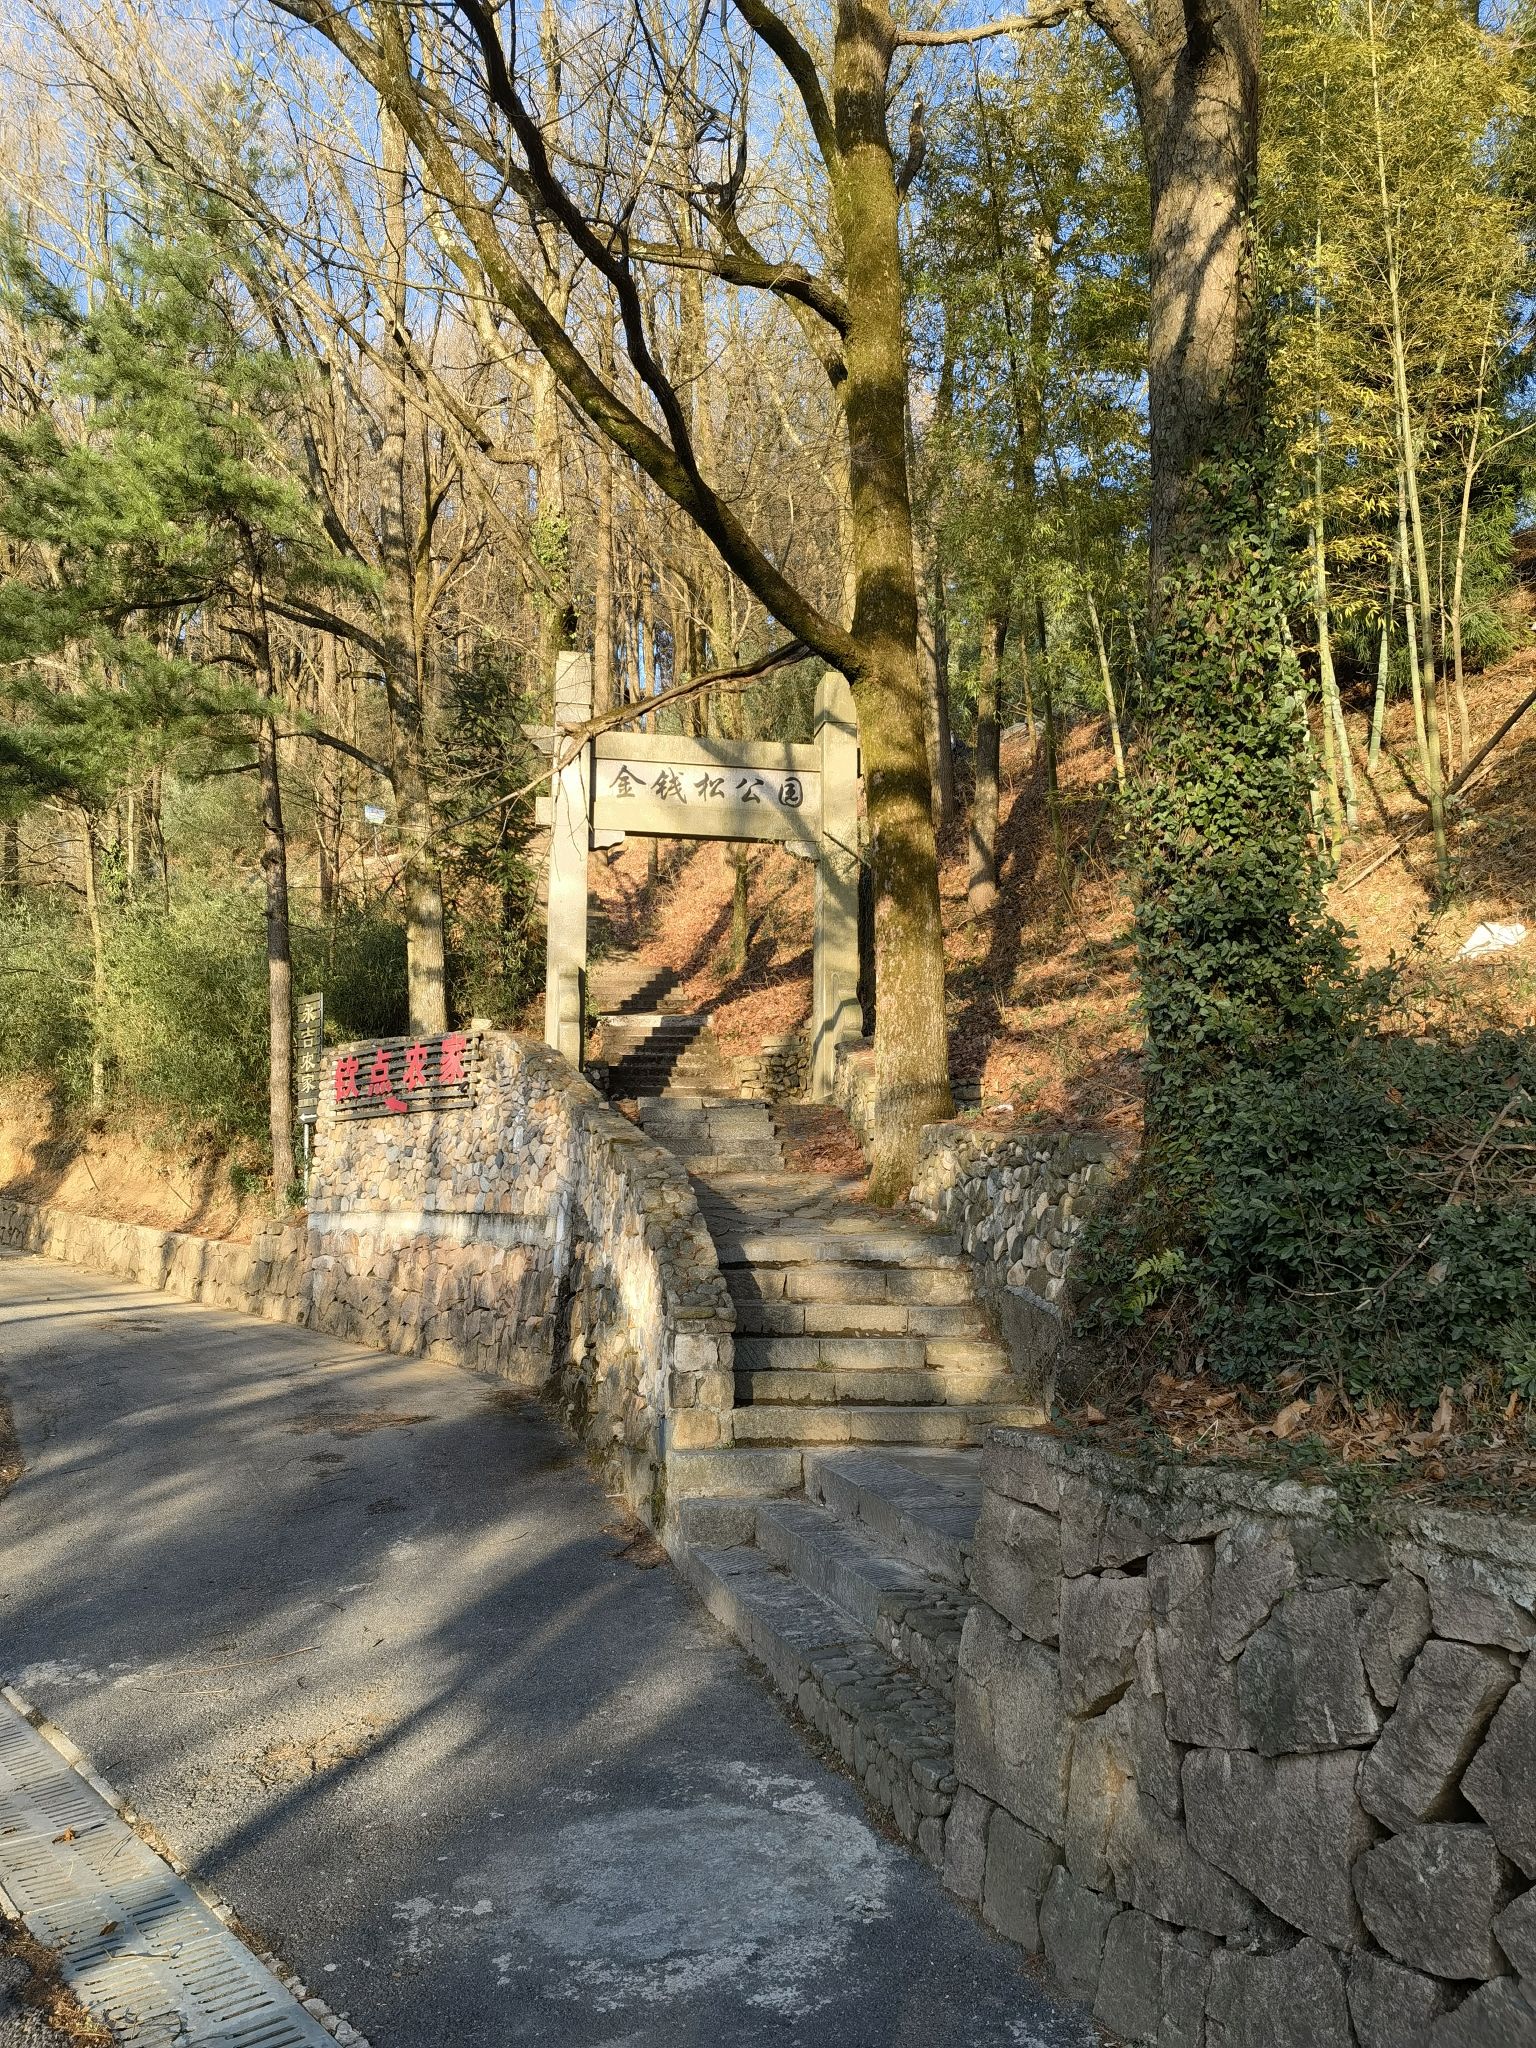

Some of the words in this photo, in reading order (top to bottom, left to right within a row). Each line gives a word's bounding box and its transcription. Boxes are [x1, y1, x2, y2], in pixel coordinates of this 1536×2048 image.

[609, 764, 804, 808] 金钱松公园
[300, 1003, 317, 1094] 永吉农家
